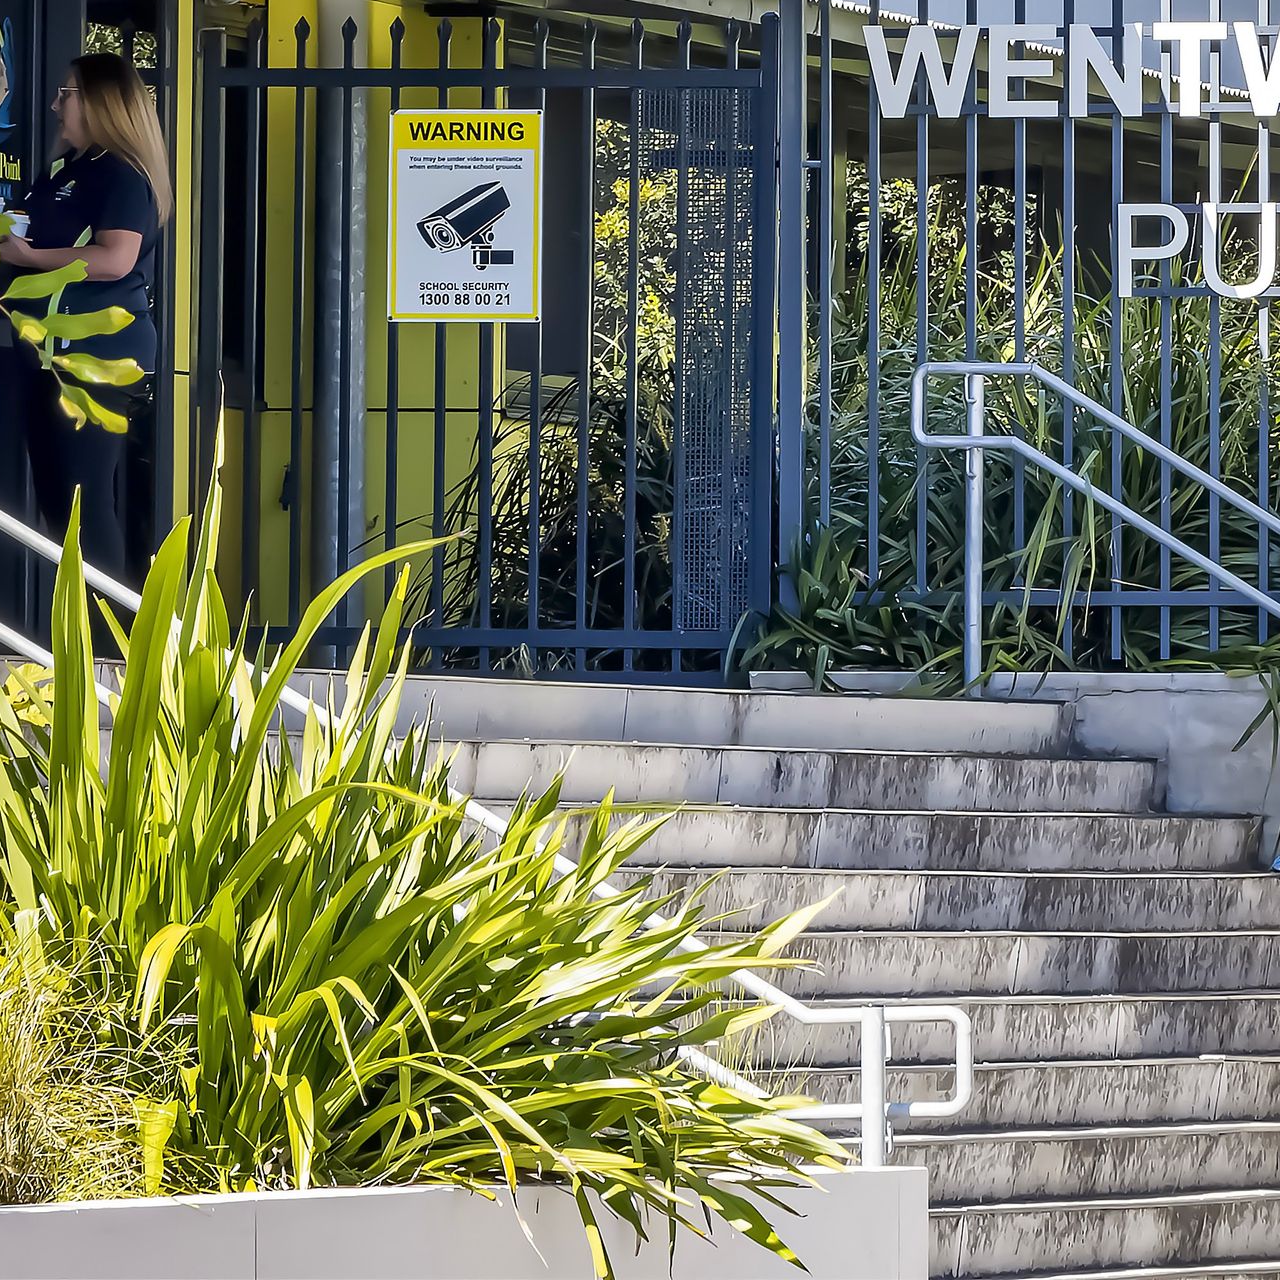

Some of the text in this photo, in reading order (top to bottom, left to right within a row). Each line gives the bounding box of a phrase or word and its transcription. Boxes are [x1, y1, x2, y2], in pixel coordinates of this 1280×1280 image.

[409, 121, 525, 142] WARNING
[0, 152, 21, 181] Point
[419, 294, 510, 305] 1300 88 00 21
